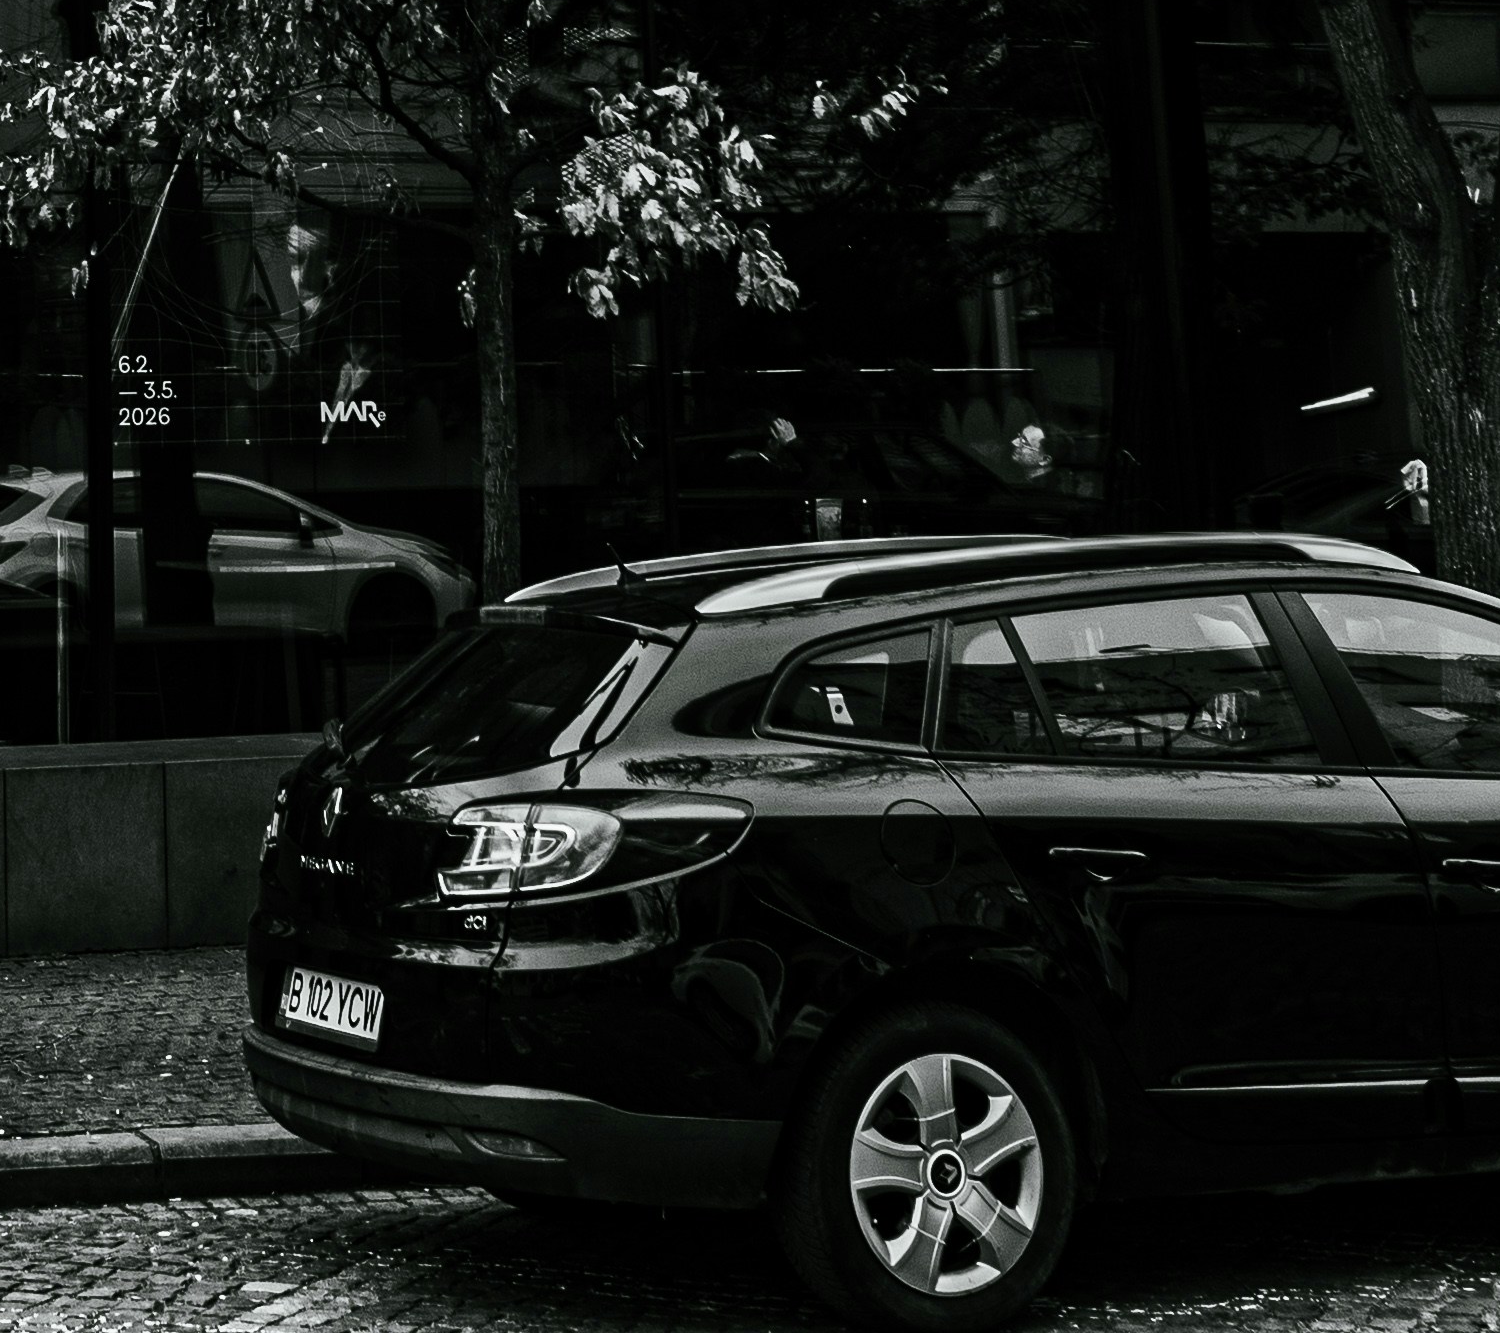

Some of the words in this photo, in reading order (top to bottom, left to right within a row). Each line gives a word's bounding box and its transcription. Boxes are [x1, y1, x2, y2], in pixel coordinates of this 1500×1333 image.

[143, 381, 178, 399] 3.5.
[118, 407, 171, 426] 2026
[288, 972, 304, 1013] B
[306, 975, 334, 1022] 102
[338, 982, 382, 1033] YCW
